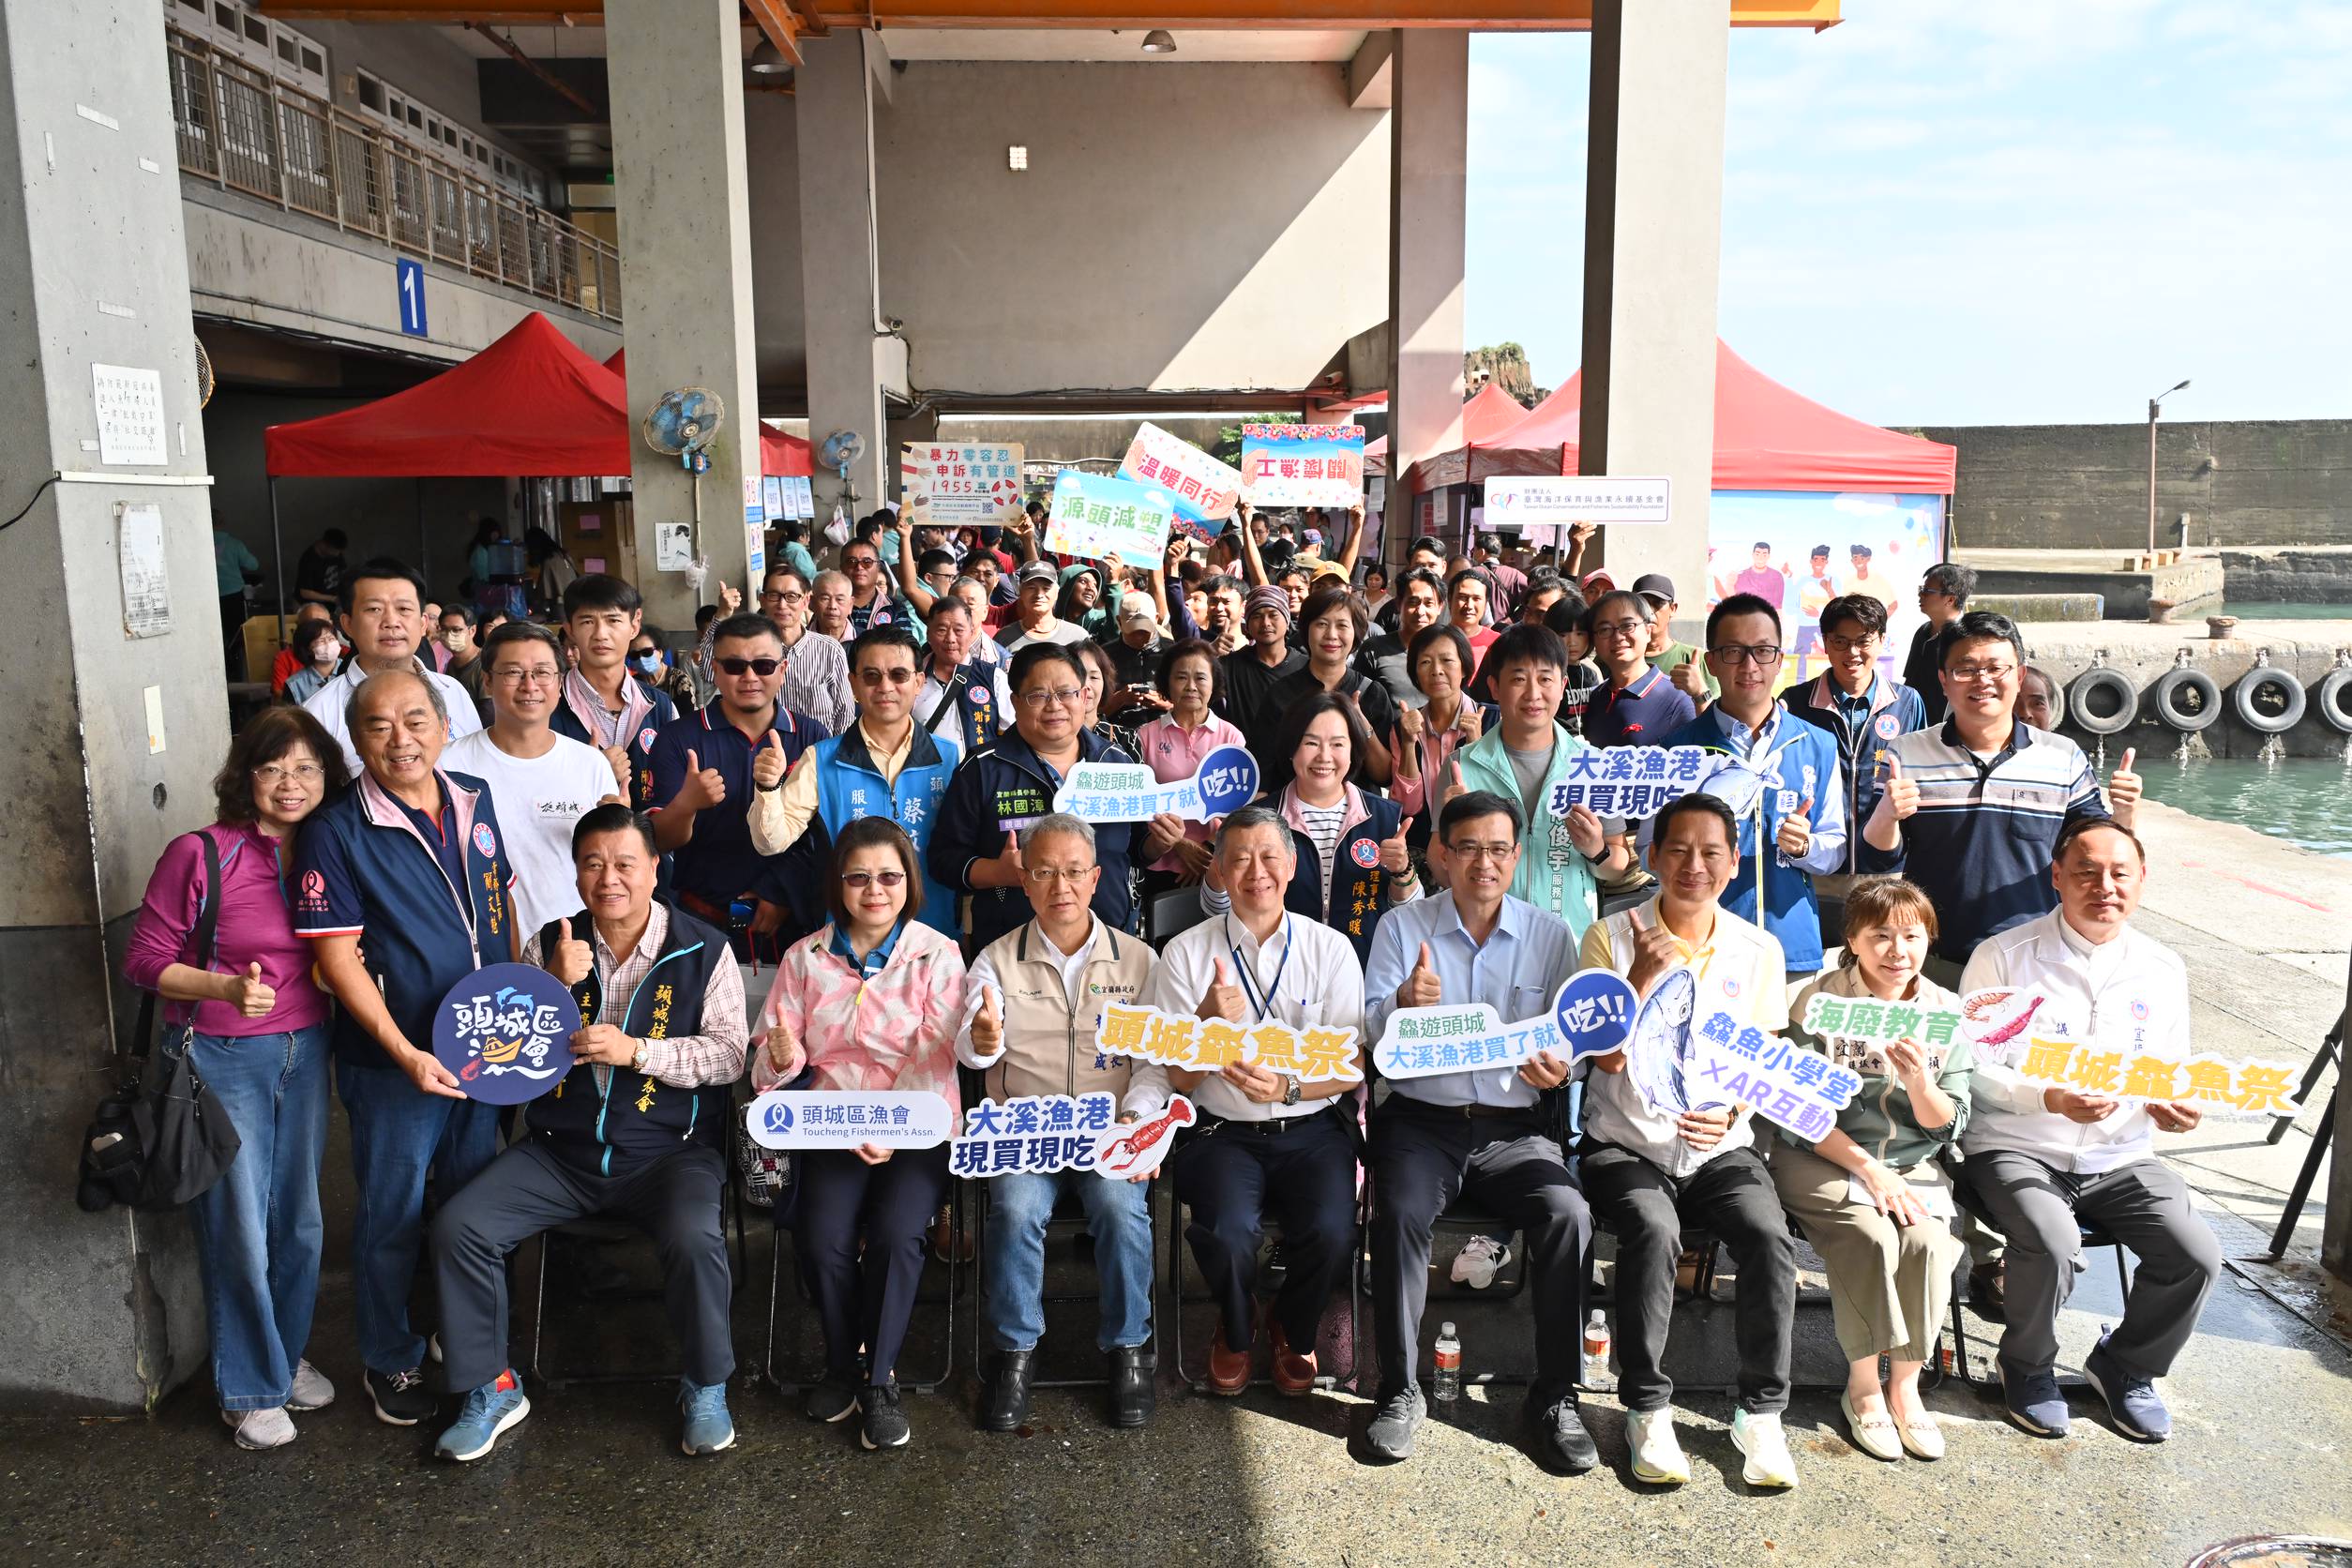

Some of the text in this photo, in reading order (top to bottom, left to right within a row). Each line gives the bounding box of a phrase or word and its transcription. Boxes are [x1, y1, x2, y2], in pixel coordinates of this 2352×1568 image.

[404, 266, 420, 329] 1
[930, 448, 1009, 461] 暴力零容忍
[937, 464, 1017, 477] 申訴有管道
[1256, 457, 1348, 480] 關懷漁工
[932, 479, 972, 493] 1955
[1137, 453, 1223, 512] 溫暖同行
[1061, 496, 1163, 535] 源頭減塑
[1076, 771, 1144, 791] 鱻遊頭城
[1568, 749, 1702, 781] 大溪漁港
[998, 799, 1045, 816] 林國漳
[1064, 789, 1198, 818] 大溪漁港買了就
[1547, 815, 1573, 918] 俊宇 服務團
[1366, 870, 1380, 911] 理事長
[1349, 882, 1367, 936] 陳秀暖
[1101, 986, 1135, 994] 宜蘭縣政府
[452, 995, 564, 1039] 頭城區
[1398, 1012, 1486, 1040] 鱻遊頭城
[1807, 996, 1964, 1046] 海廢教育
[1386, 1023, 1560, 1070] 大溪漁港買了就
[1698, 1010, 1859, 1107] 鱻魚小學堂
[802, 1105, 911, 1125] 頭城區漁會
[803, 1127, 936, 1138] Toucheng Fishermen's Assn.
[970, 1096, 1111, 1137] 大溪漁港
[955, 1134, 1096, 1174] 現買現吃
